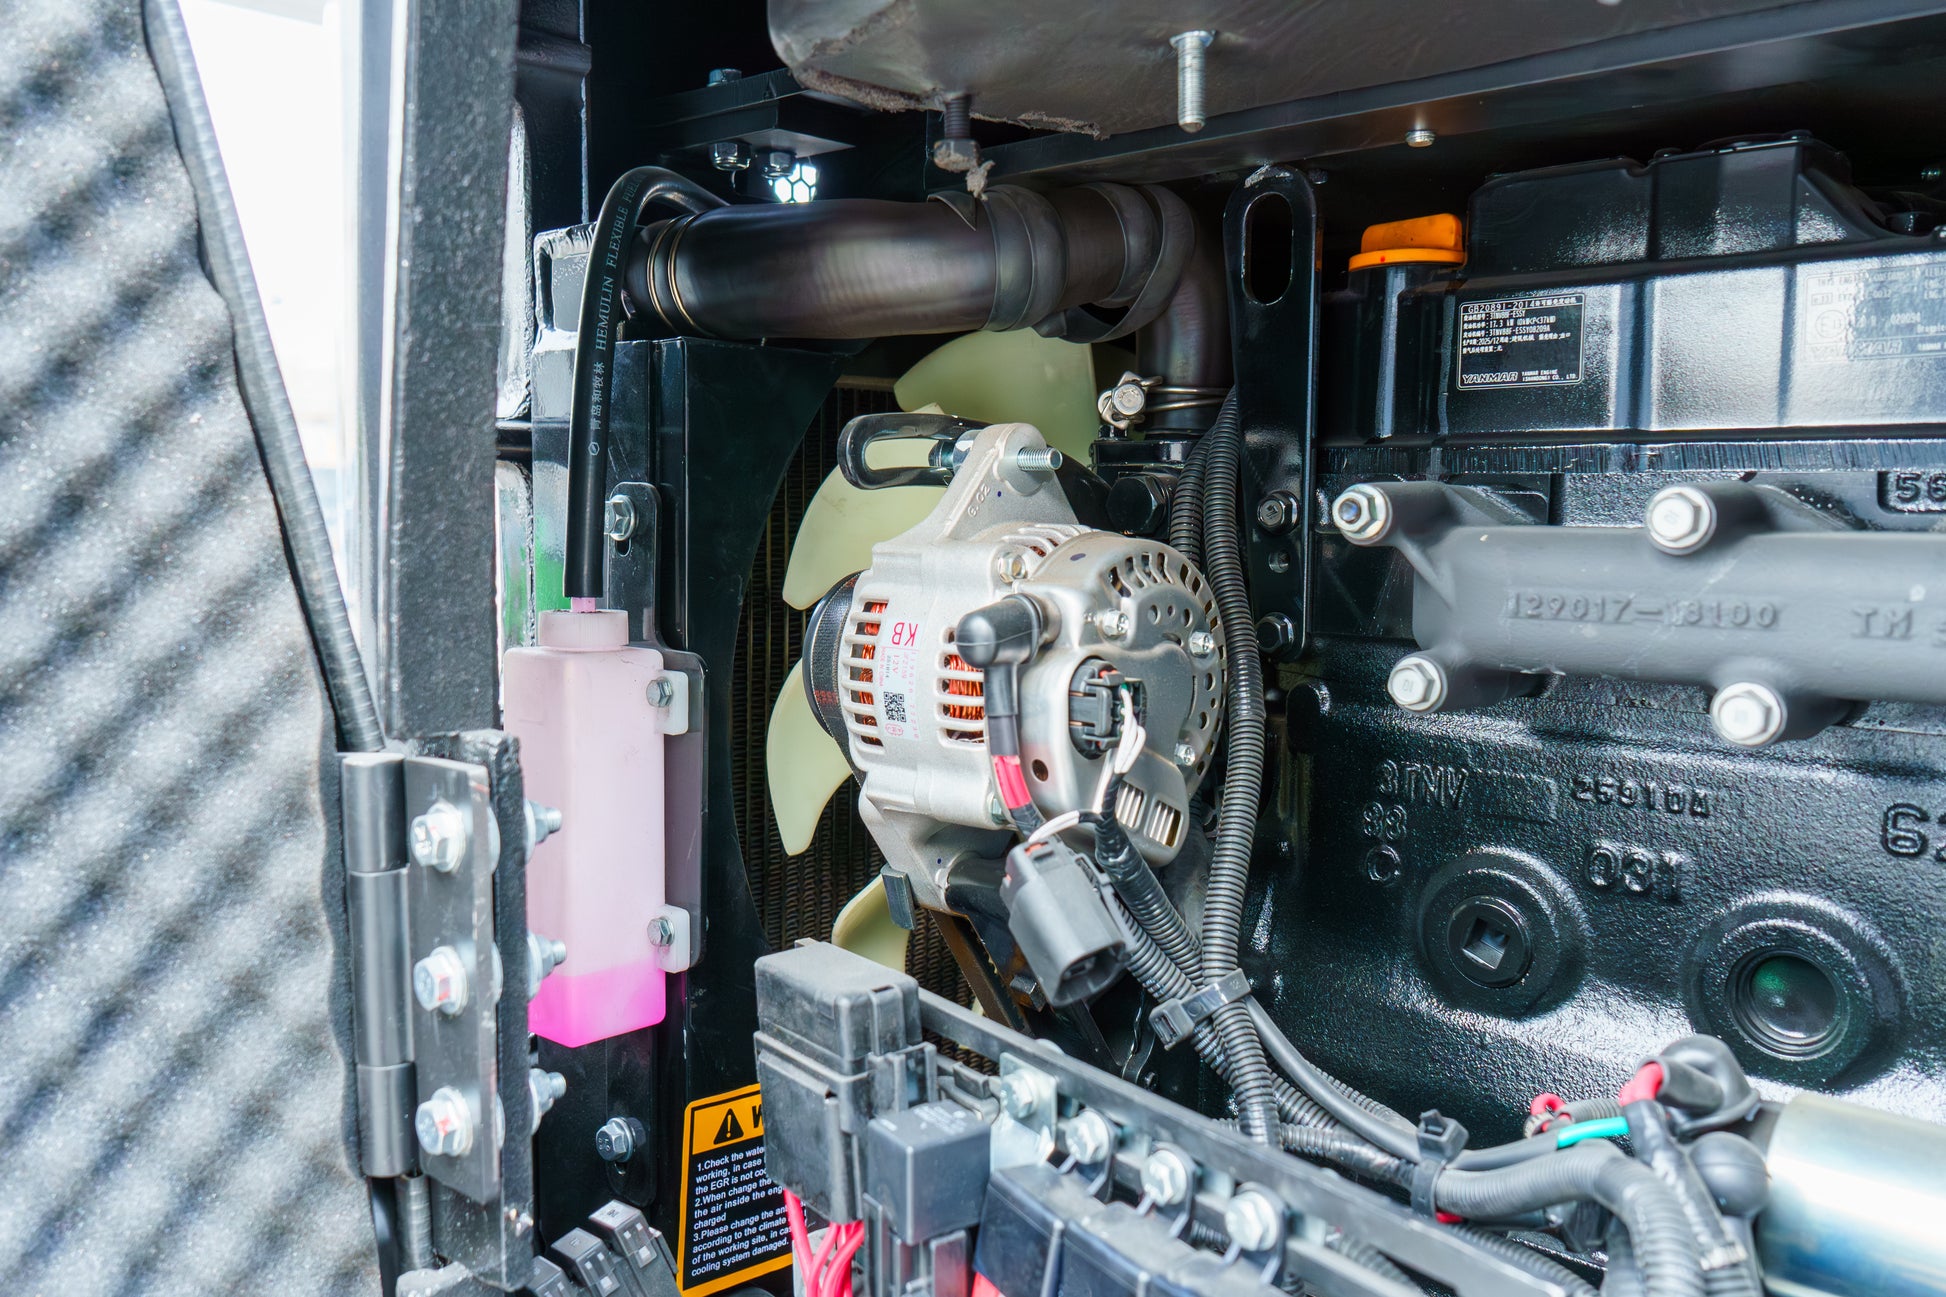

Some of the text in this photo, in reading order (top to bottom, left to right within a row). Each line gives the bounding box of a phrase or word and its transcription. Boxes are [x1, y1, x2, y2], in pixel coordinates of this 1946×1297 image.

[595, 275, 615, 351] HEMULIN
[605, 206, 629, 269] FLEXIBLE
[1462, 371, 1519, 384] YANMAR
[891, 621, 919, 648] KB
[695, 1169, 731, 1184] working,
[732, 1164, 741, 1173] in
[742, 1158, 762, 1170] case
[697, 1145, 766, 1172] 1.Check the wate
[694, 1178, 772, 1207] 2.When change the
[695, 1185, 709, 1196] the
[710, 1178, 730, 1191] EGR
[731, 1176, 739, 1185] is
[740, 1170, 753, 1182] not
[694, 1208, 708, 1219] the
[710, 1203, 723, 1214] air
[724, 1196, 750, 1210] inside
[752, 1190, 766, 1201] the
[692, 1217, 787, 1254] according to the climate
[693, 1212, 727, 1230] charged
[693, 1225, 729, 1242] 3.Please
[730, 1215, 760, 1230] change
[761, 1208, 774, 1220] the
[691, 1255, 702, 1265] of
[702, 1250, 716, 1262] the
[717, 1239, 750, 1256] working
[770, 1230, 778, 1240] in
[691, 1237, 790, 1278] cooling system damaged.
